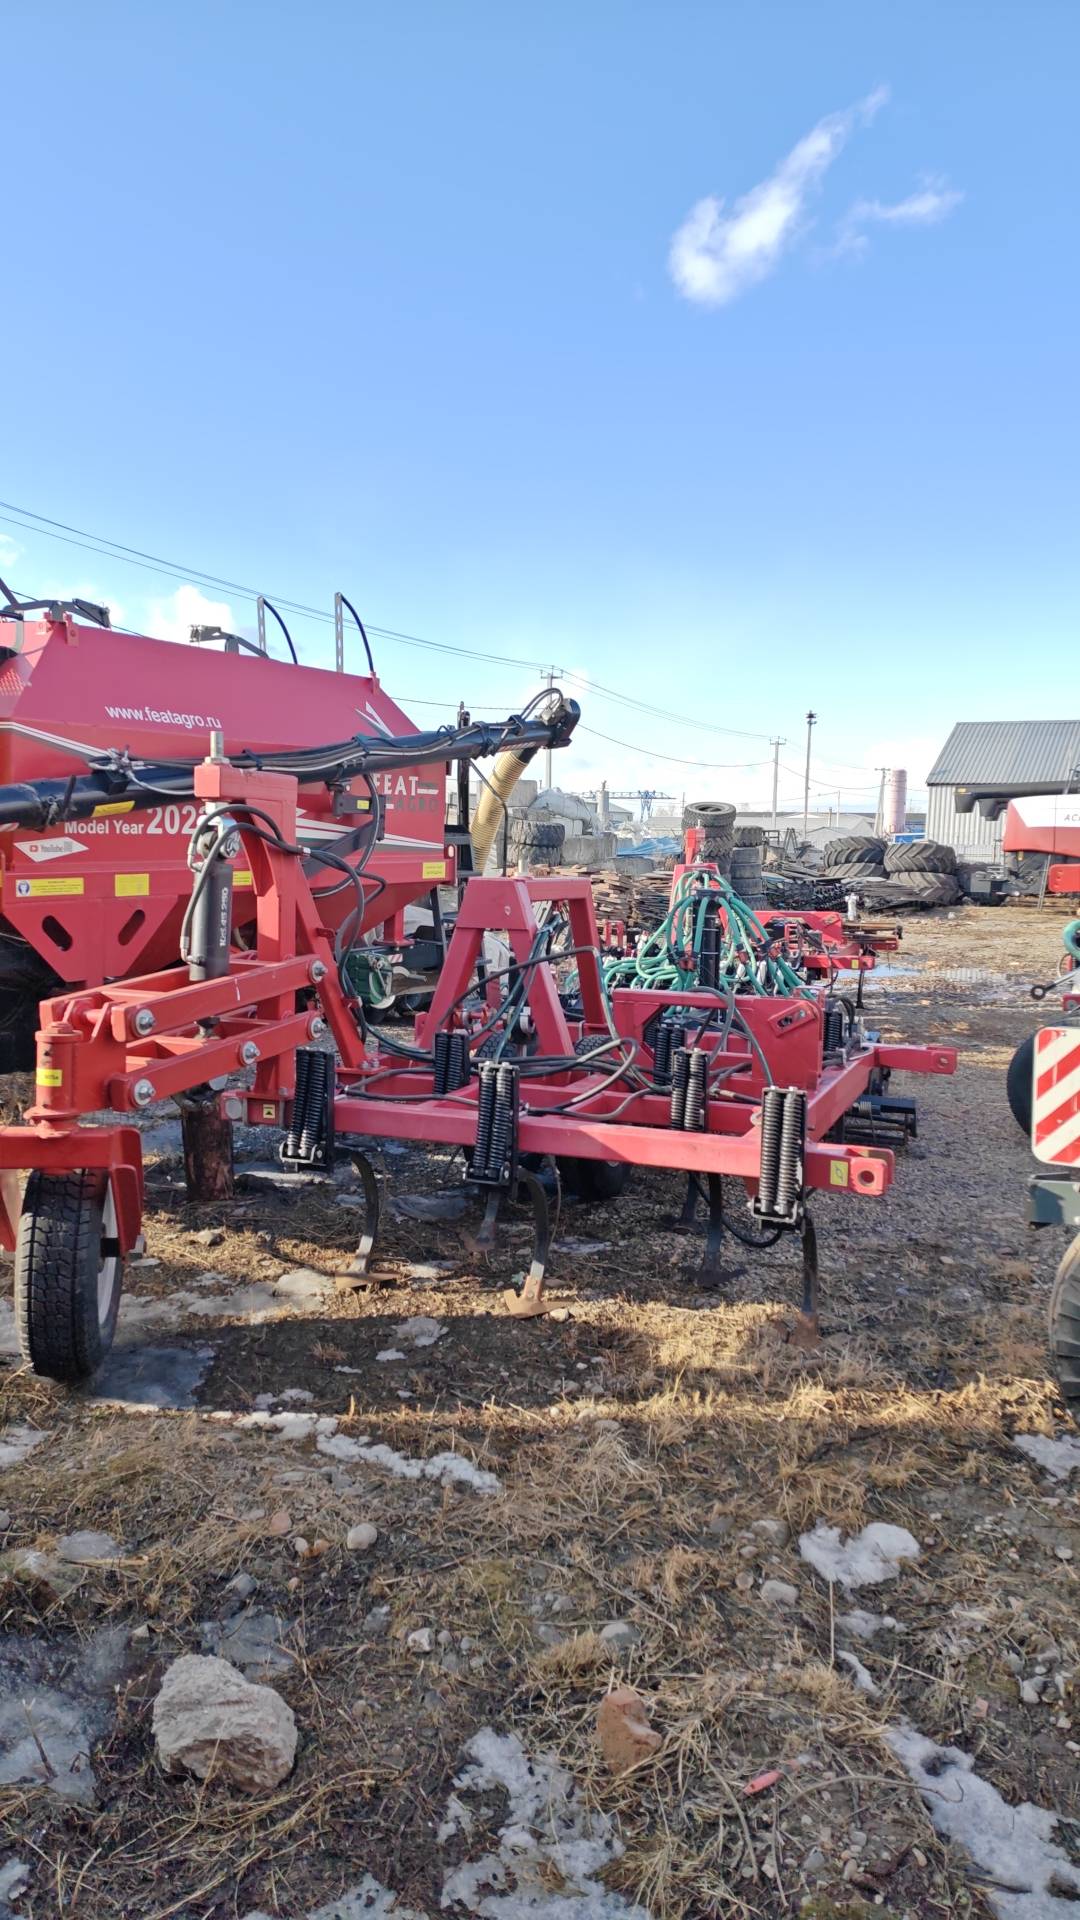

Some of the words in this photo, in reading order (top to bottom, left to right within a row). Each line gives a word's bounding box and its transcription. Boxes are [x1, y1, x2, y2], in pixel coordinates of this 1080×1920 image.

[104, 705, 222, 729] www.featagro.ru
[370, 772, 419, 796] FEAT
[64, 820, 109, 834] Model
[113, 820, 144, 835] Year
[146, 804, 206, 835] 202
